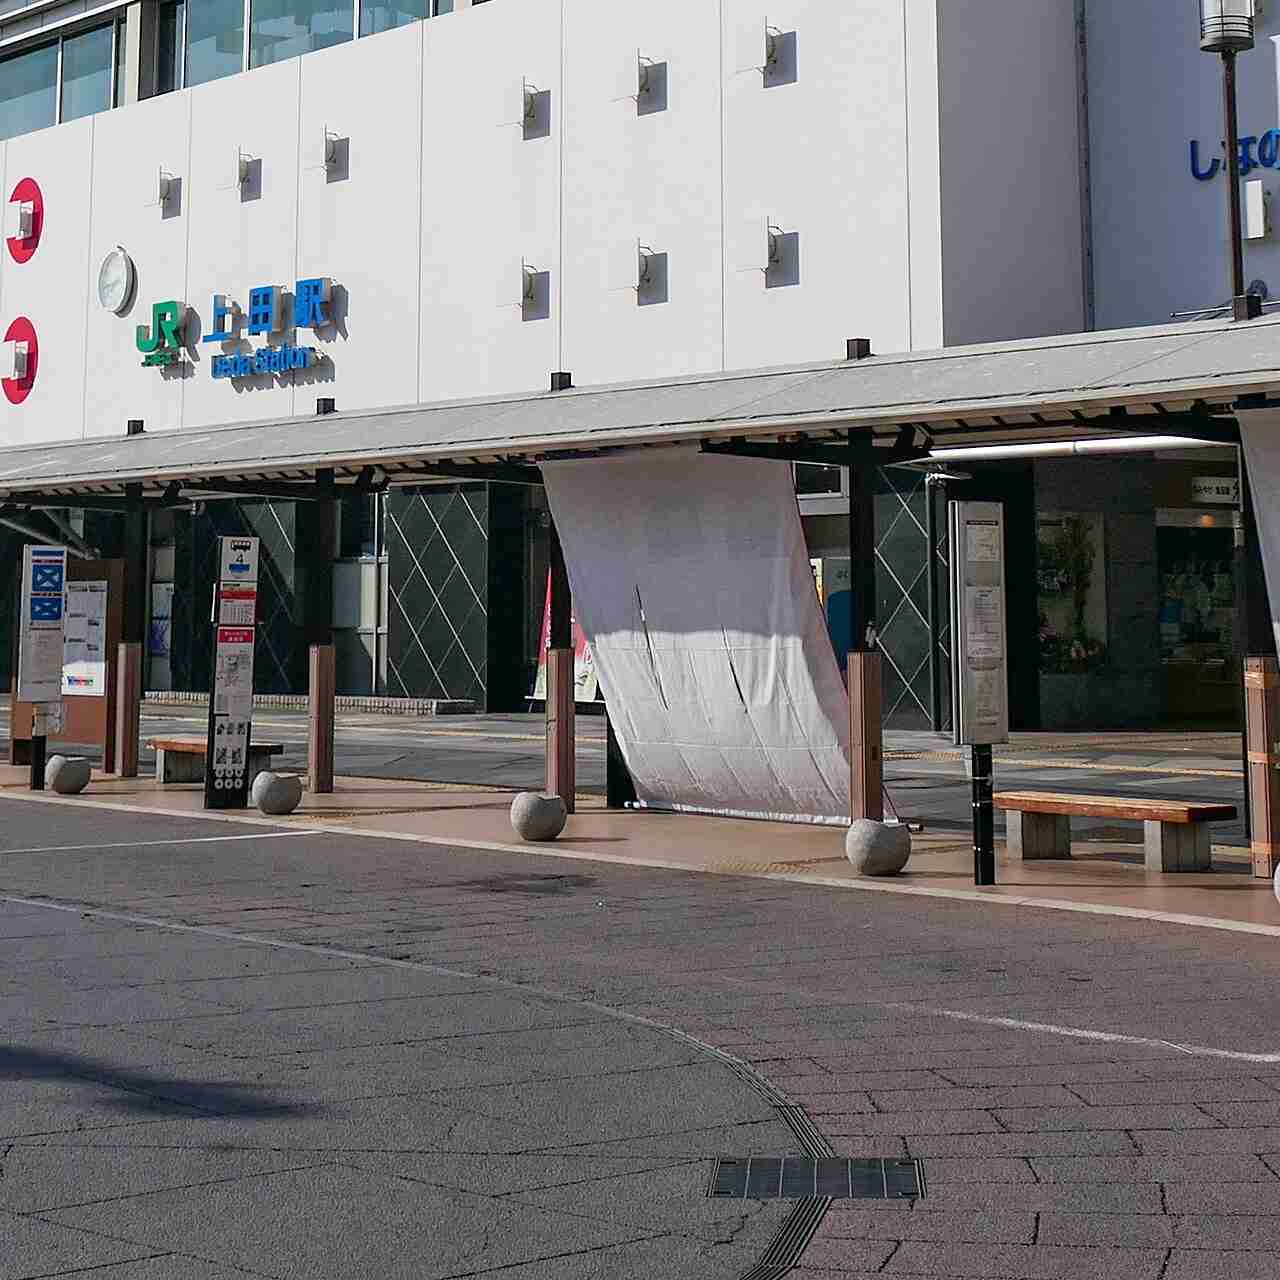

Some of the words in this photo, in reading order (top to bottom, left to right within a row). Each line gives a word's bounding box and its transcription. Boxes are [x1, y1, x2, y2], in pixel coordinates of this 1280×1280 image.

[136, 300, 184, 353] JR
[203, 277, 335, 343] 上田駅
